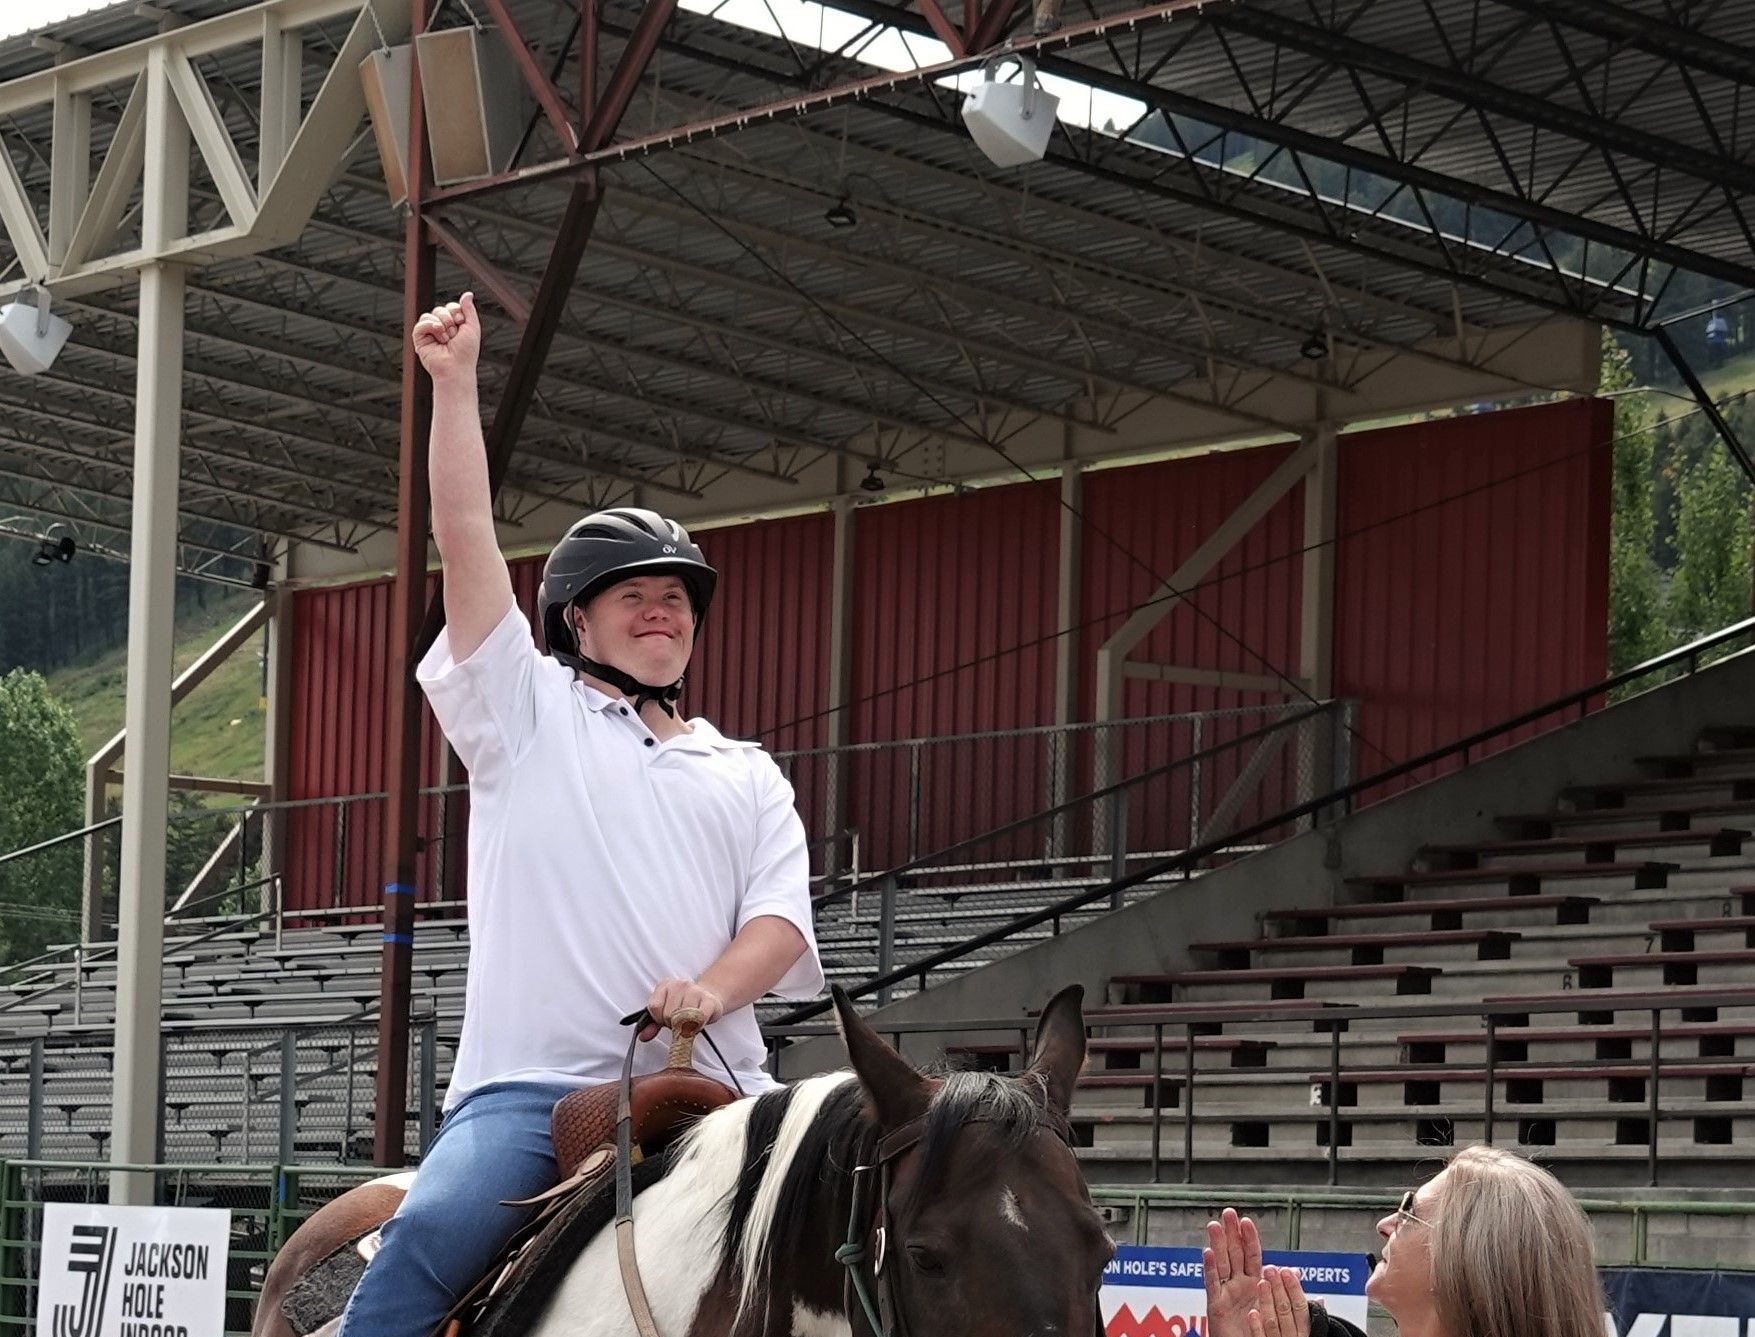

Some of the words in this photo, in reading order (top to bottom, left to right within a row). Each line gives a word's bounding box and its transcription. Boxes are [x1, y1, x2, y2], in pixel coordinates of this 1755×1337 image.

[124, 1242, 210, 1280] JACKSON
[1123, 1260, 1167, 1276] HOLE'S
[1170, 1262, 1204, 1277] SAFE
[1299, 1266, 1351, 1284] XPERTS
[121, 1283, 165, 1319] HOLE
